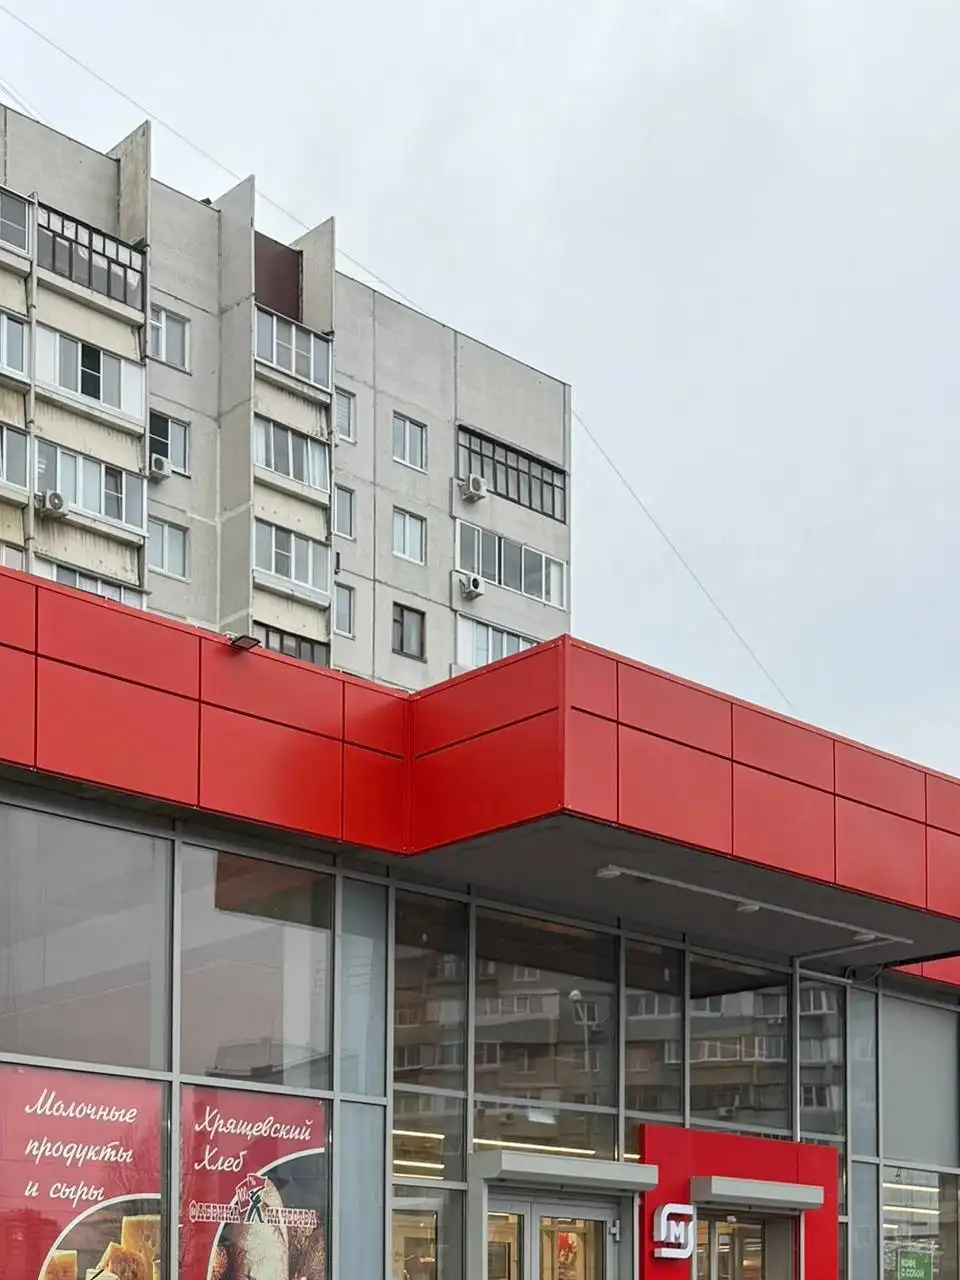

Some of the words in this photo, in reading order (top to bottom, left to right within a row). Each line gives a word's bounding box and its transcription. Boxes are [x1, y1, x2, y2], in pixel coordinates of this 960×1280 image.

[24, 1089, 138, 1123] Молочные
[194, 1106, 312, 1141] Хрящевский
[24, 1138, 134, 1166] продукты
[194, 1147, 248, 1172] Хлеб
[24, 1180, 40, 1198] и
[49, 1184, 104, 1208] сыры
